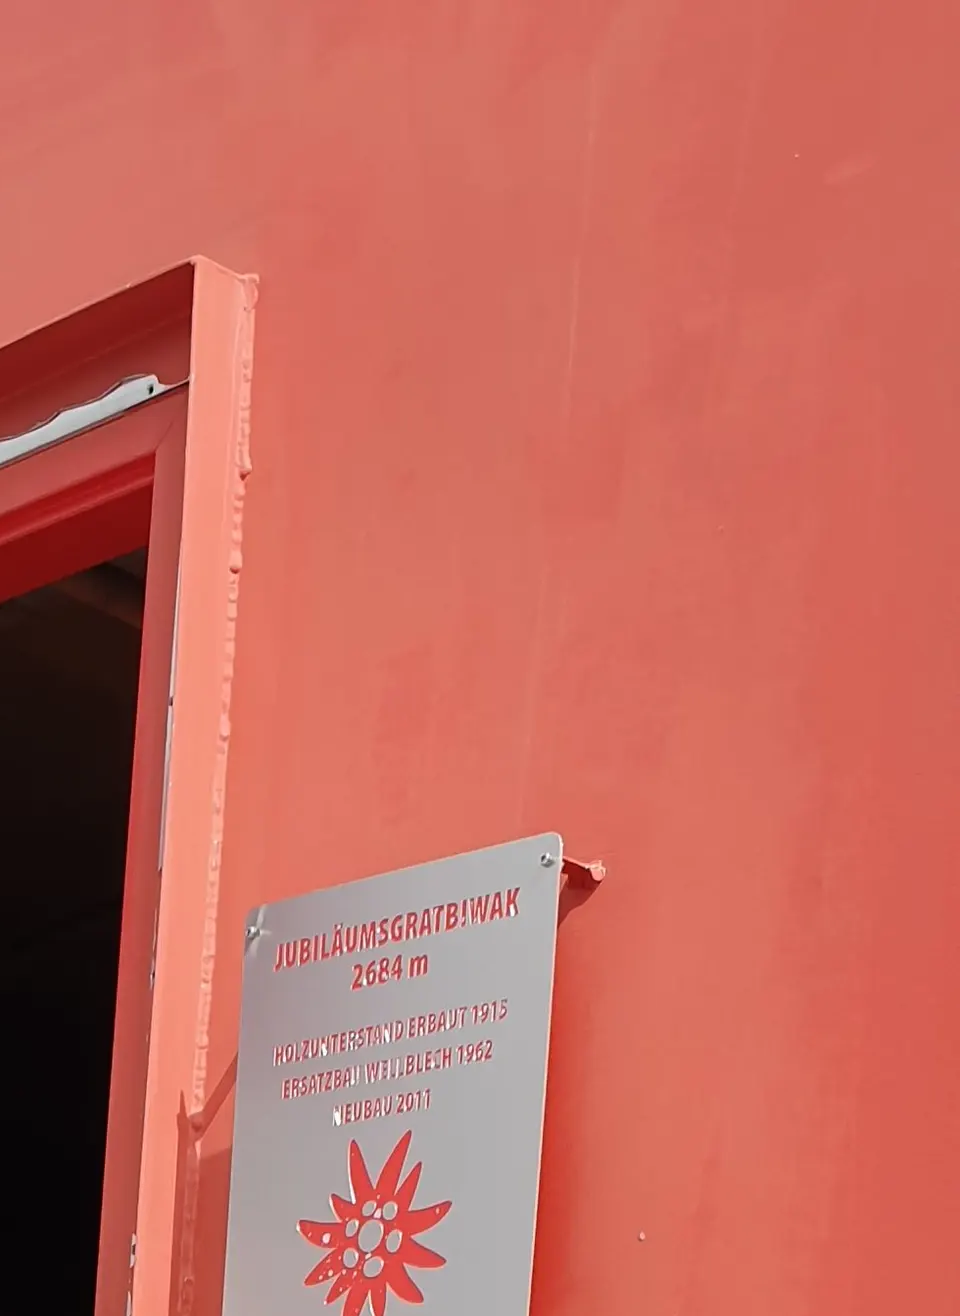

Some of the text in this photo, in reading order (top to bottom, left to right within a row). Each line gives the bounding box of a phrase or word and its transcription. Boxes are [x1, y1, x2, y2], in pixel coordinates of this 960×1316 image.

[273, 888, 520, 970] JUBILÄUMSGRATBIWAK
[350, 954, 429, 991] 2684 m
[272, 998, 508, 1067] HOLZUNTERSTAND ERBAUT 1915
[281, 1039, 494, 1100] ERSATZBAU WELLBLECH 1962
[332, 1088, 431, 1127] NEUBAU 2011
